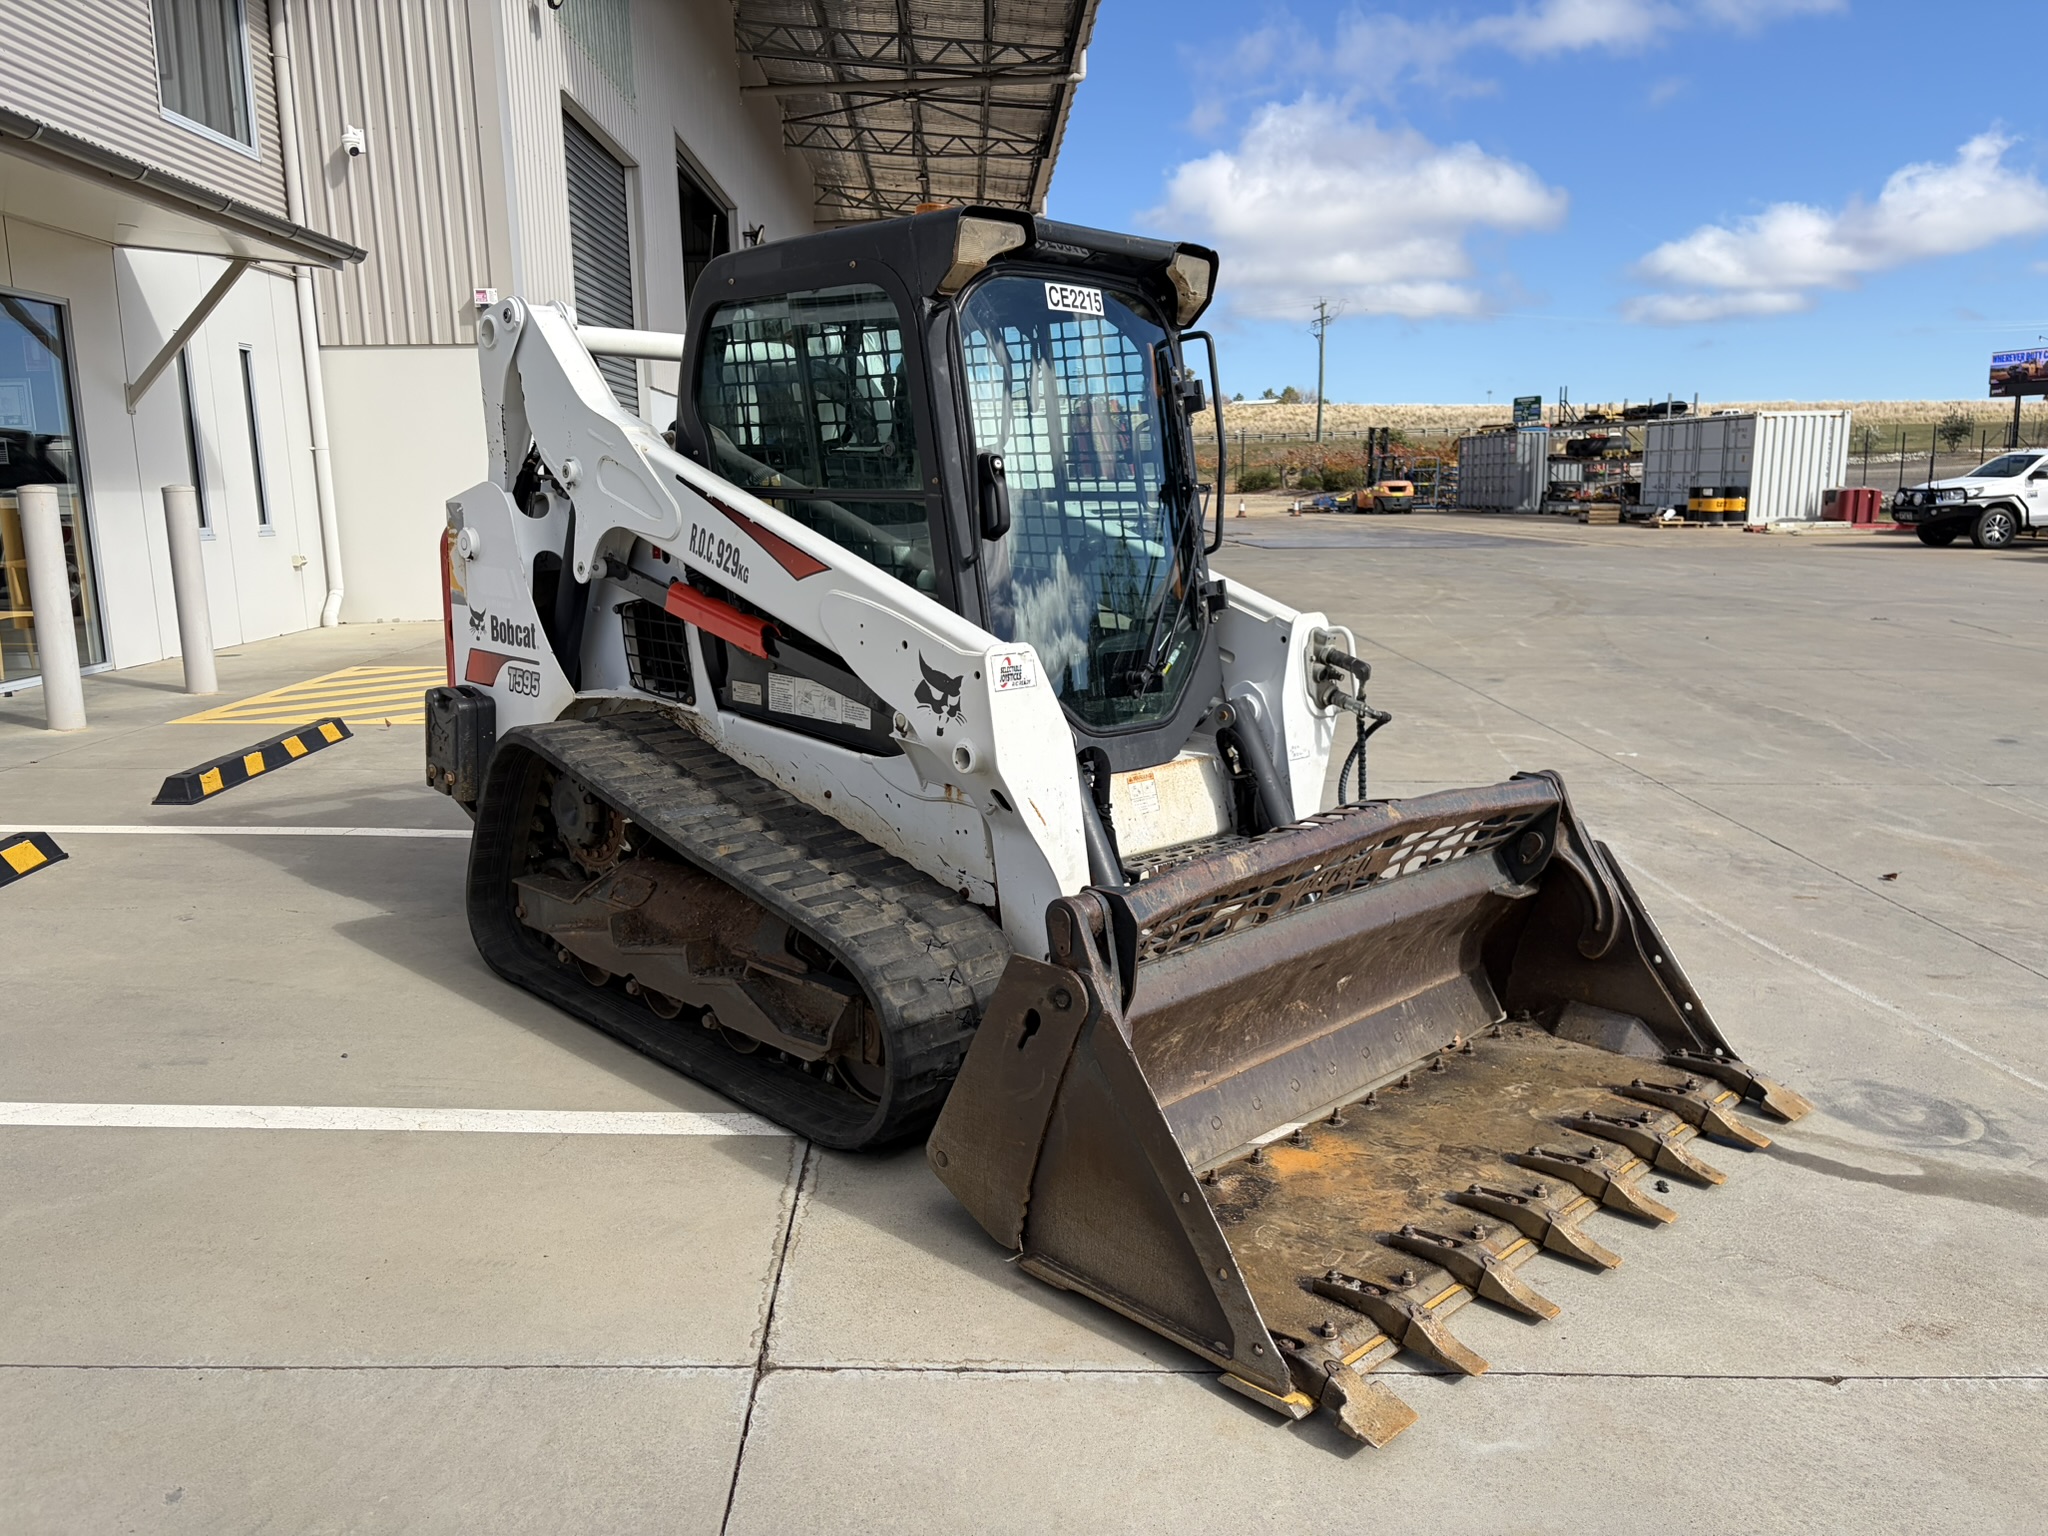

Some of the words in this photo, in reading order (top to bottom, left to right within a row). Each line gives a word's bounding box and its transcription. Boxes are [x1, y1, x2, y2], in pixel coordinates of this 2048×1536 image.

[1048, 285, 1102, 312] CE2215
[1992, 352, 2025, 363] WHEREVER
[2026, 350, 2043, 361] DUTY
[490, 614, 536, 650] Bobcat
[507, 665, 540, 697] T595
